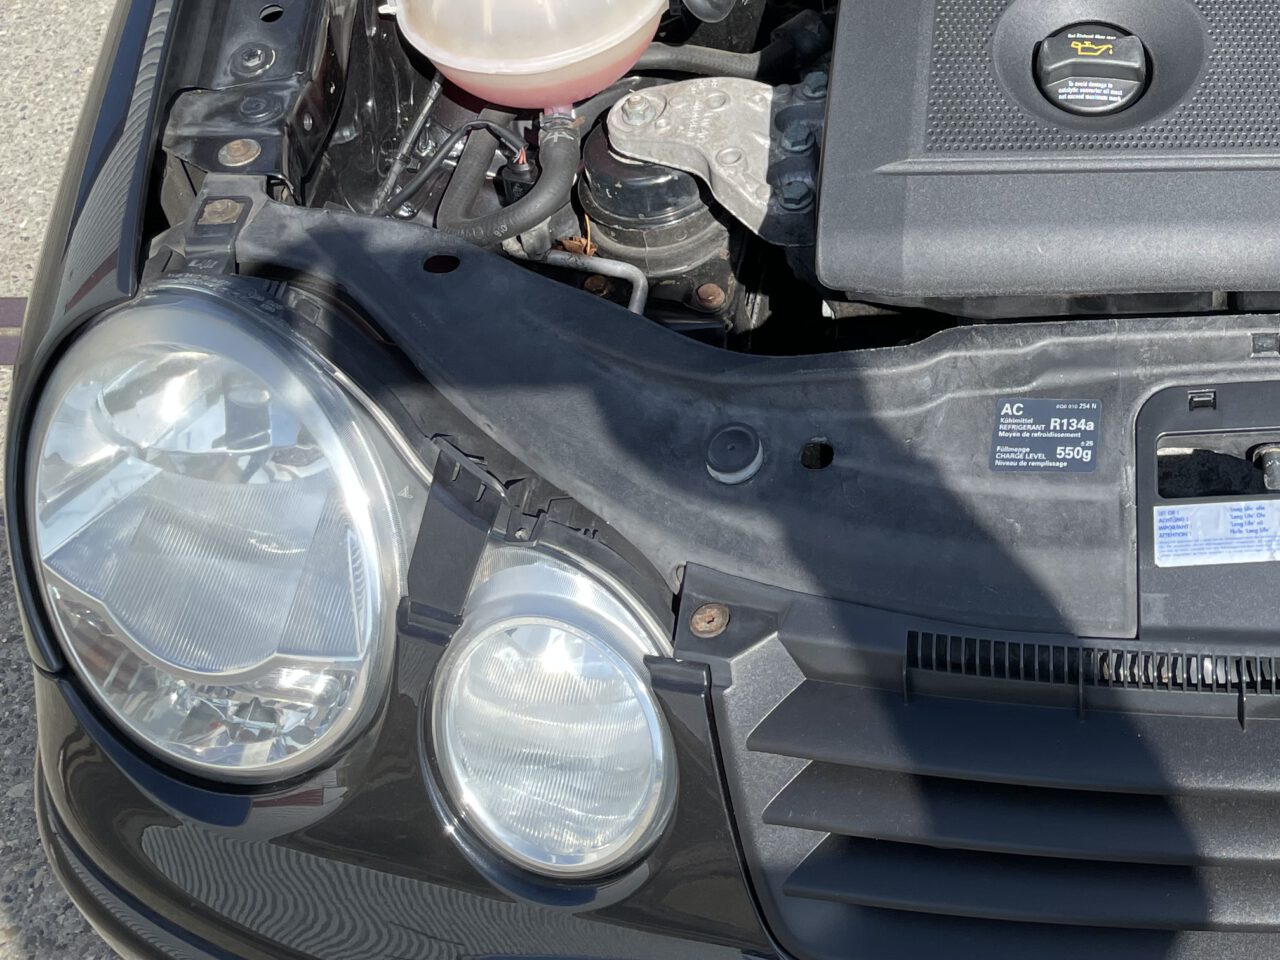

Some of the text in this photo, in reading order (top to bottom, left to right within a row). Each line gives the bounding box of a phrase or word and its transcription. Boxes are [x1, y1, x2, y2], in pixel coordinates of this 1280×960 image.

[1000, 403, 1024, 416] AC
[1050, 418, 1094, 430] R134a
[1056, 447, 1091, 462] 550g
